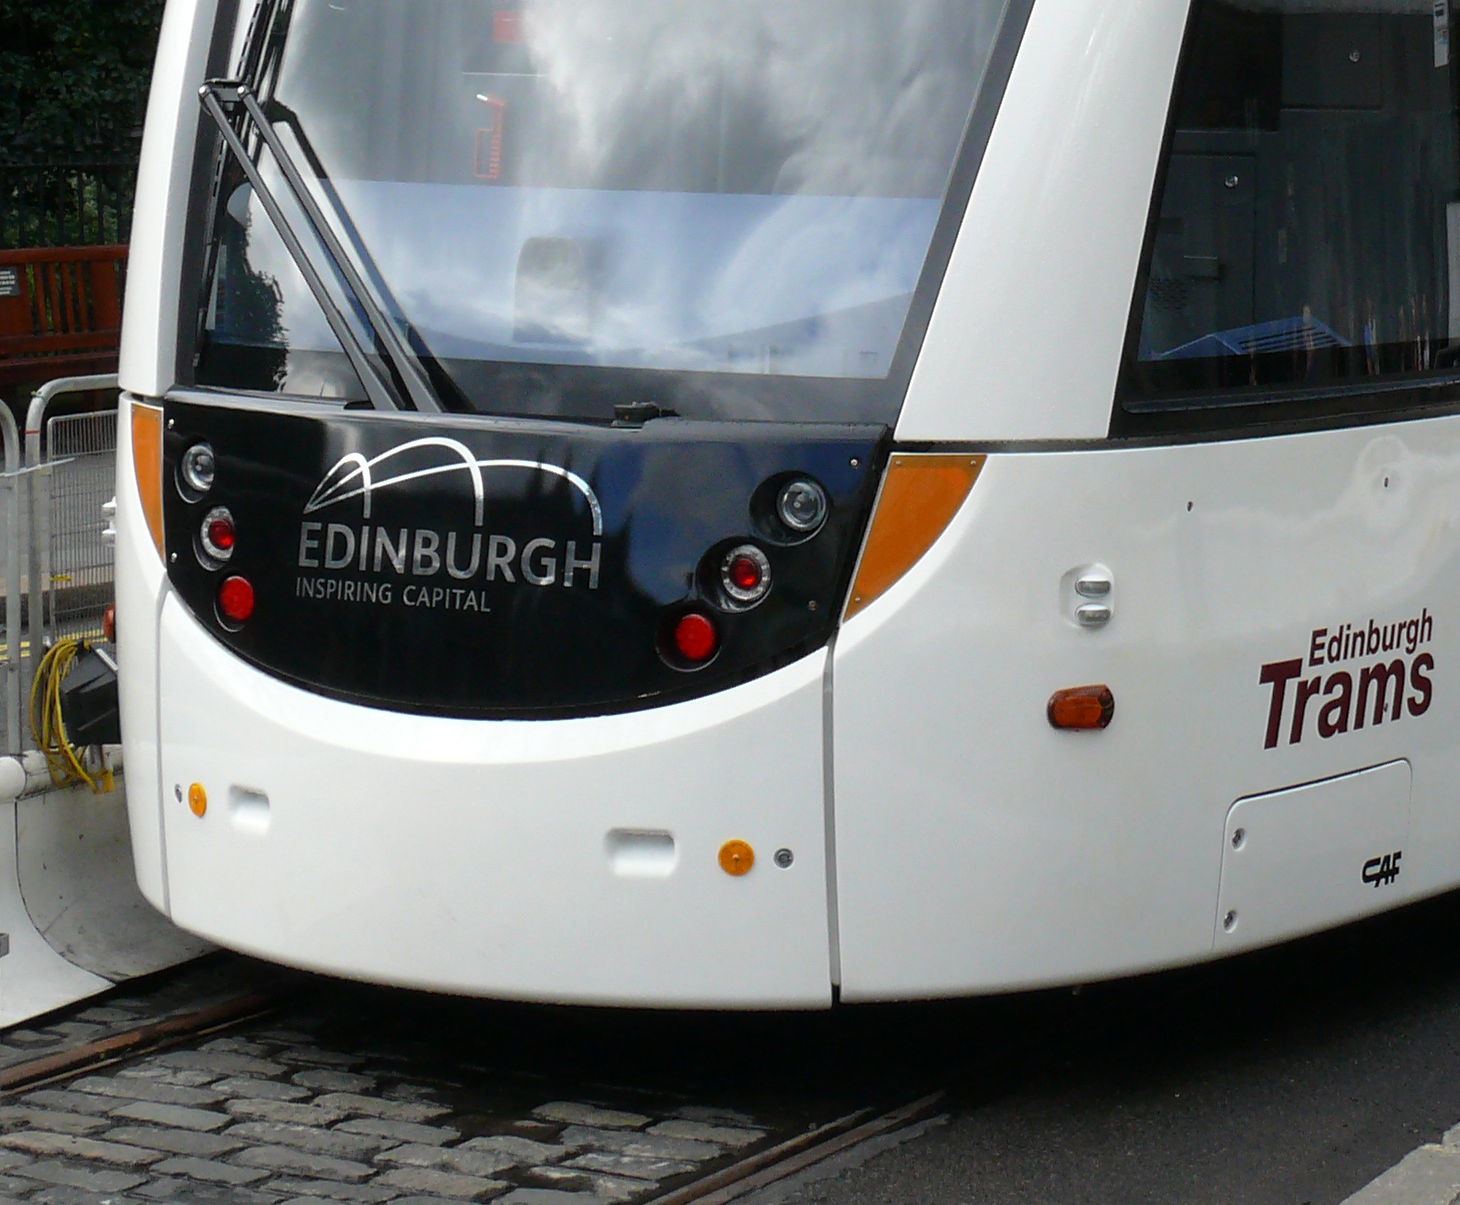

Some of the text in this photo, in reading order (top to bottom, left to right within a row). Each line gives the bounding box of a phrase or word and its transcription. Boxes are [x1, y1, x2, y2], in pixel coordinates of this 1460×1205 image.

[298, 521, 601, 589] EDINBURGH
[296, 577, 491, 613] INSPIRING CAPITAL
[1308, 608, 1434, 667] Edinburgh
[1259, 652, 1435, 750] Trams
[1362, 850, 1402, 888] CAF
